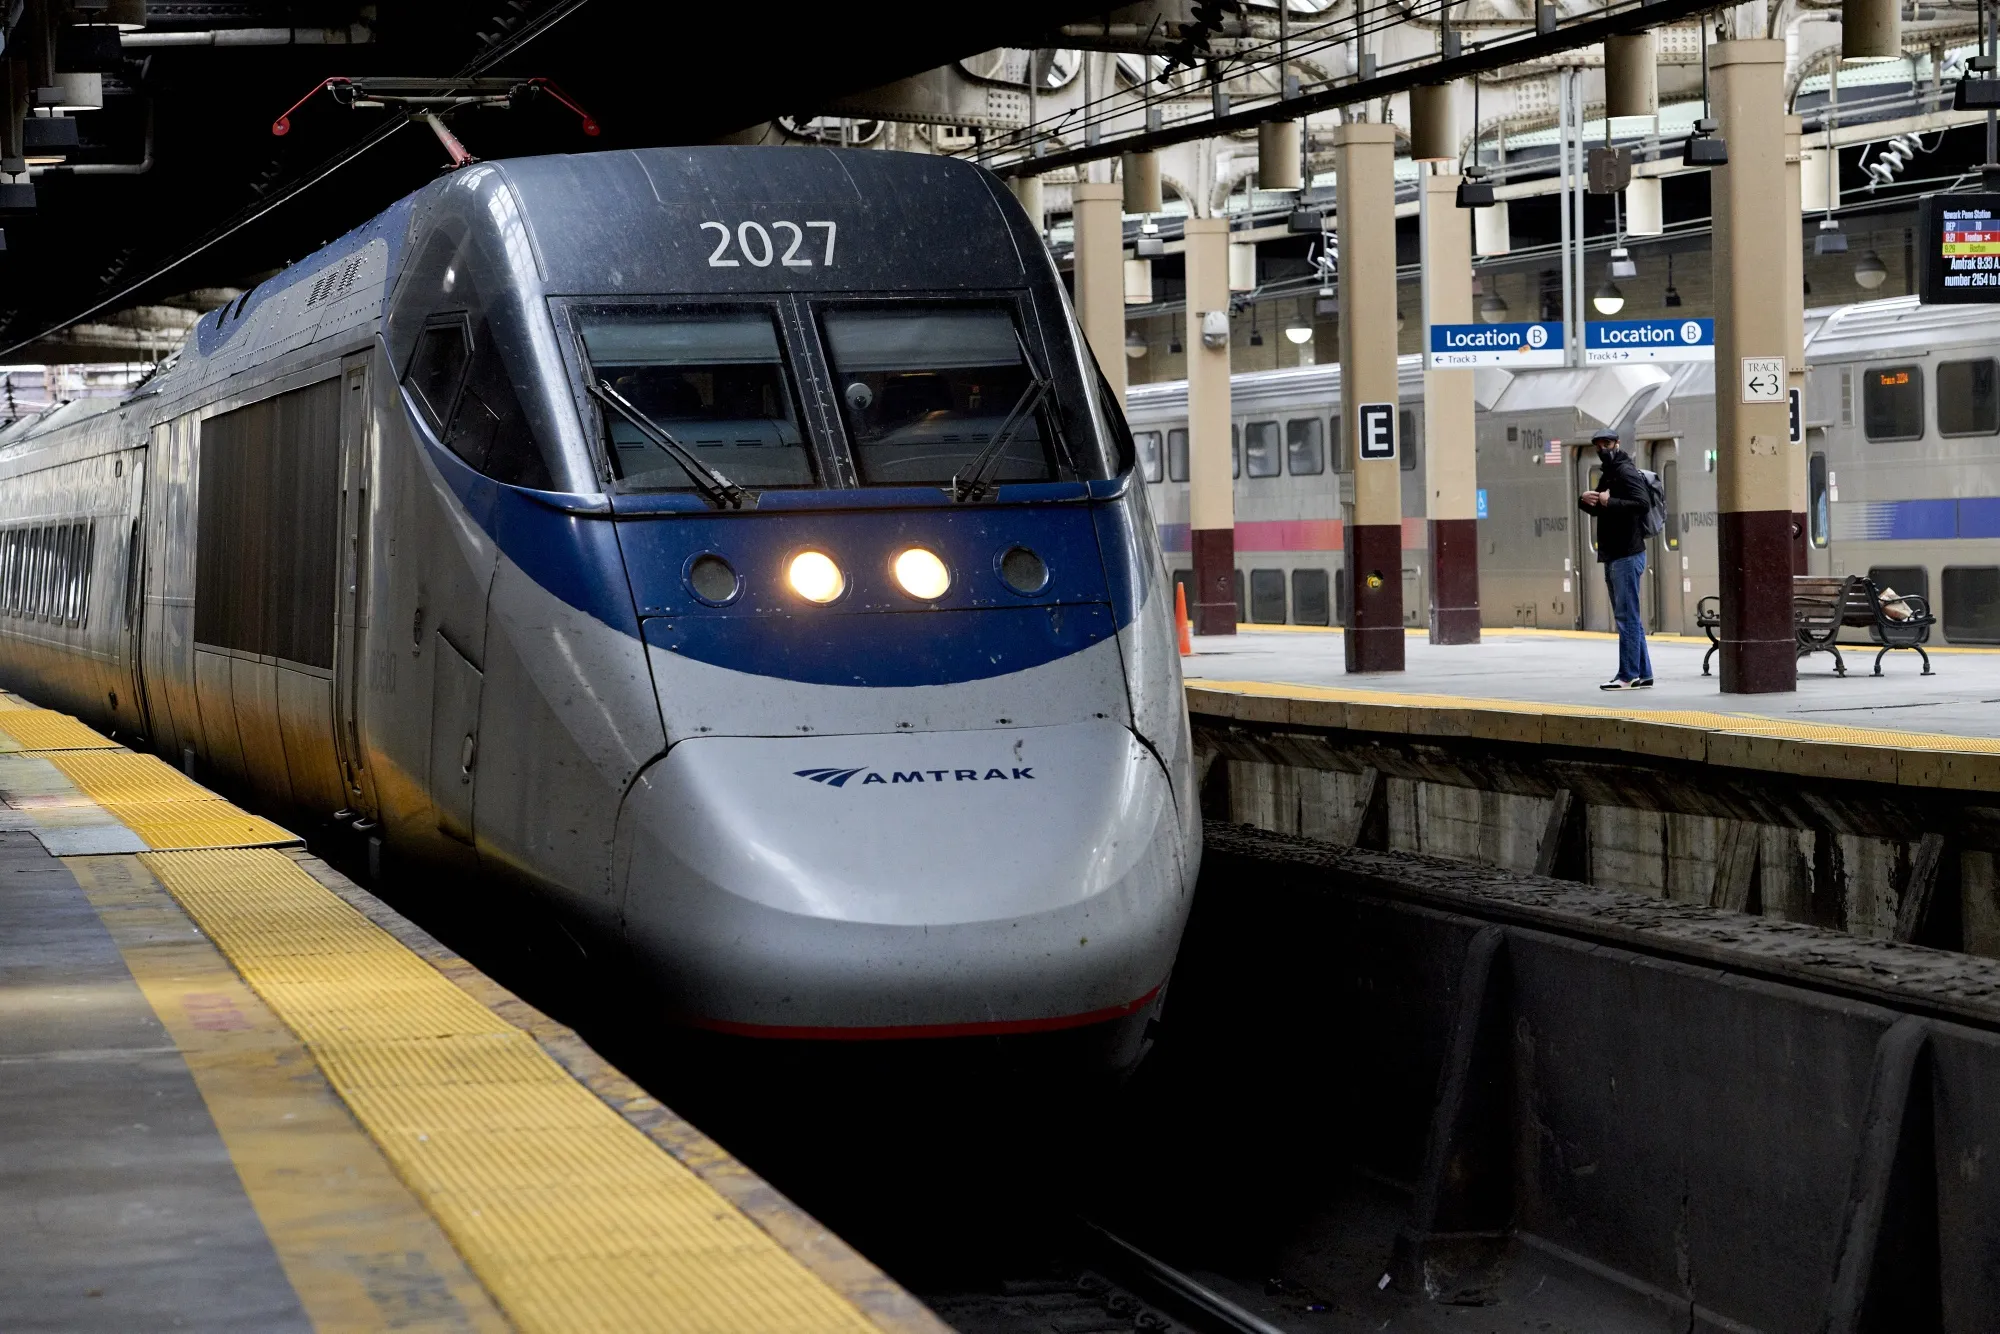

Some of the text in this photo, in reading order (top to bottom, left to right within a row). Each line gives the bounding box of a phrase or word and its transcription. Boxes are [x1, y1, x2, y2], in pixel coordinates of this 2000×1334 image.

[1943, 210, 1991, 219] Newark Penn Station
[1945, 222, 1956, 231] DEP
[1975, 221, 1982, 230] TO
[700, 220, 837, 268] 2027
[1964, 233, 1983, 242] Trenton
[1969, 244, 1986, 252] Boston
[1951, 257, 1976, 270] Amtrak
[1977, 257, 1993, 269] 9:33
[1945, 274, 1971, 286] number
[1972, 273, 1988, 286] 2154
[1989, 273, 1997, 286] to
[1446, 329, 1543, 347] Location B
[1600, 325, 1697, 344] Location B
[1448, 355, 1477, 364] Track 3
[1588, 351, 1618, 360] Track 4
[1747, 362, 1780, 372] TRACK
[1767, 373, 1779, 395] 3
[1367, 412, 1389, 451] E
[1521, 428, 1543, 450] 7016
[861, 767, 1036, 785] AMTRAK
